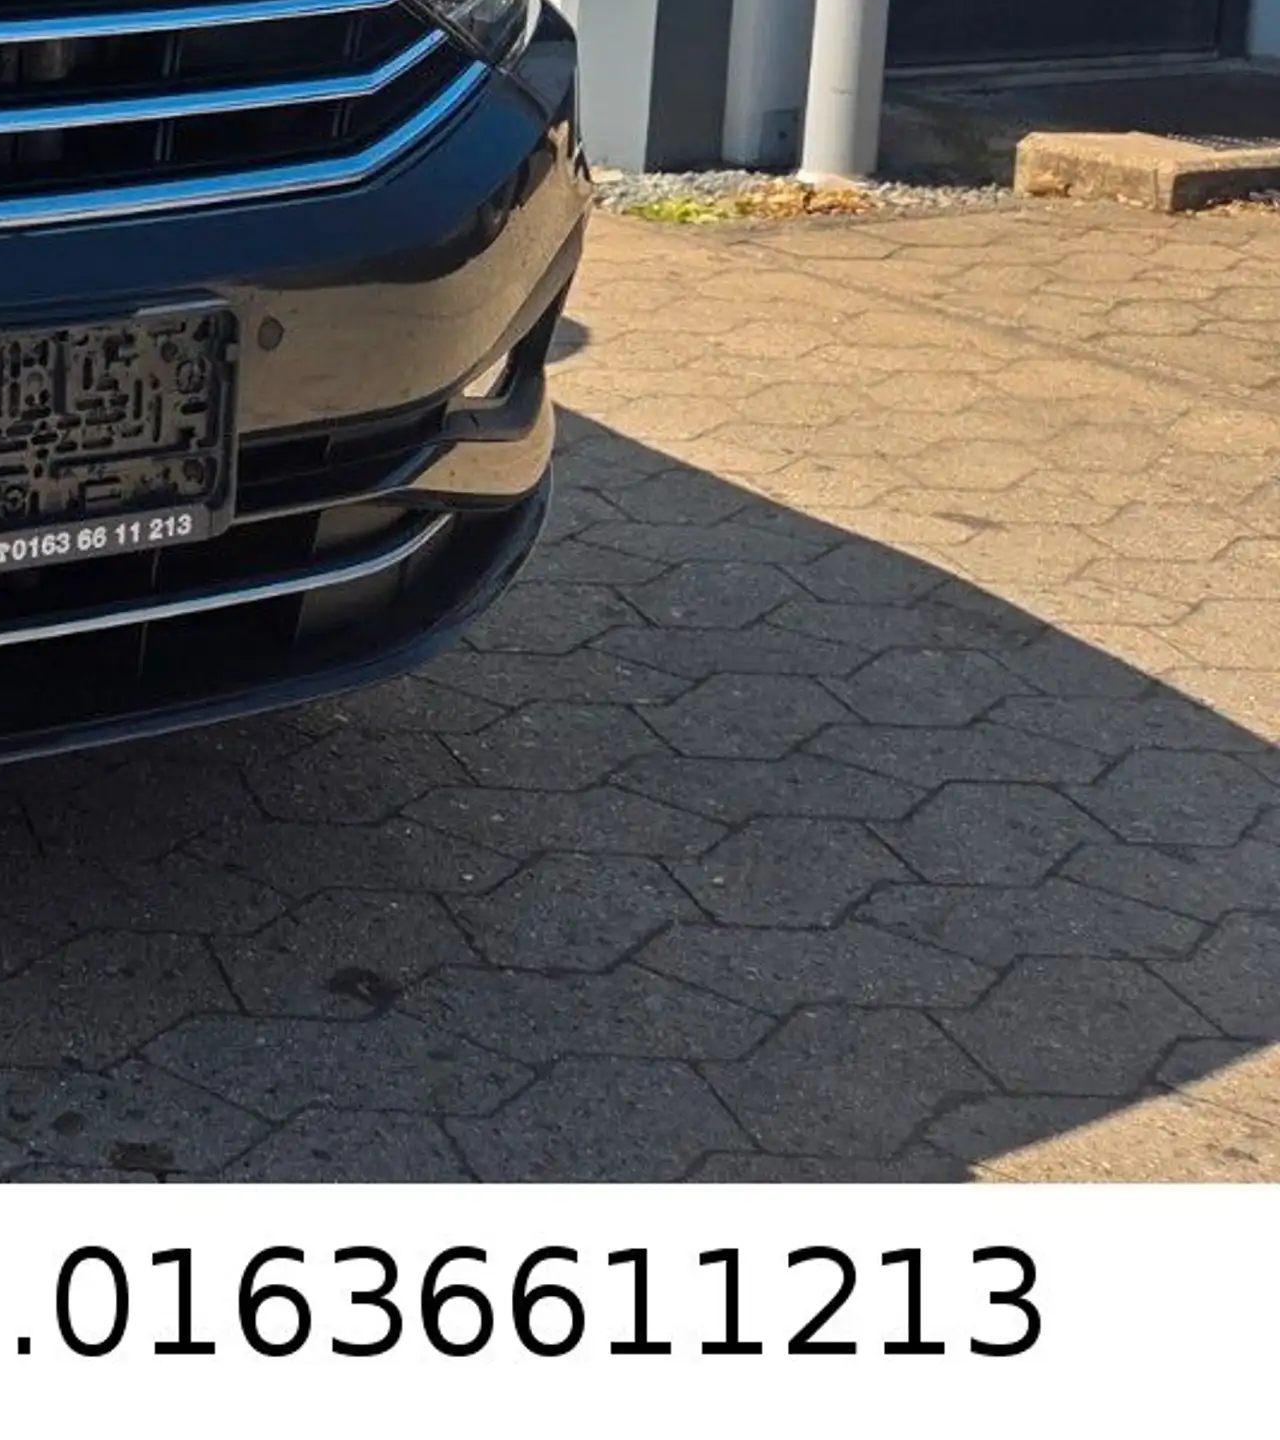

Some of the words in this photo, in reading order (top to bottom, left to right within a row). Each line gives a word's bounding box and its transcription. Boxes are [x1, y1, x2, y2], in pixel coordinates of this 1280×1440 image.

[12, 531, 71, 561] 0163
[77, 526, 107, 552] 66
[114, 519, 141, 546] 11
[148, 513, 193, 542] 213
